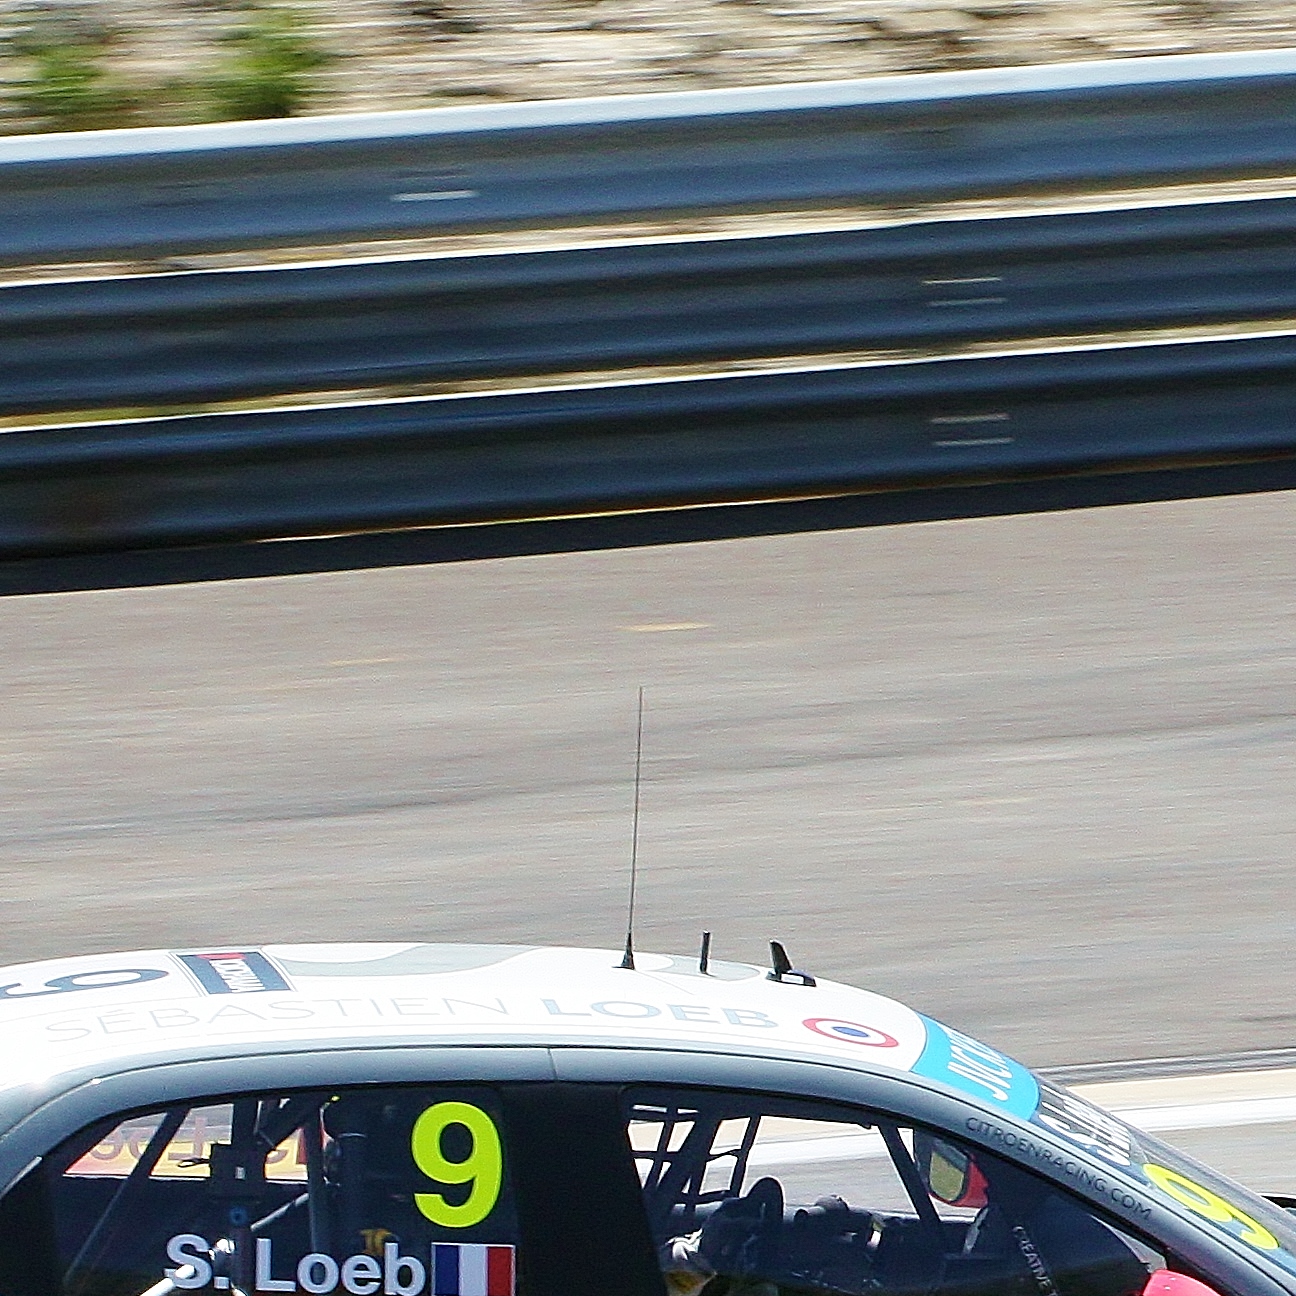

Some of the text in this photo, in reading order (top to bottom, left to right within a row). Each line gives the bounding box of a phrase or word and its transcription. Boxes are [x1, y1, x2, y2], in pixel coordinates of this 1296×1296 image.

[541, 998, 779, 1029] LOEB
[410, 1101, 502, 1228] 9
[1143, 1163, 1279, 1250] 9
[164, 1232, 426, 1296] S. Loeb
